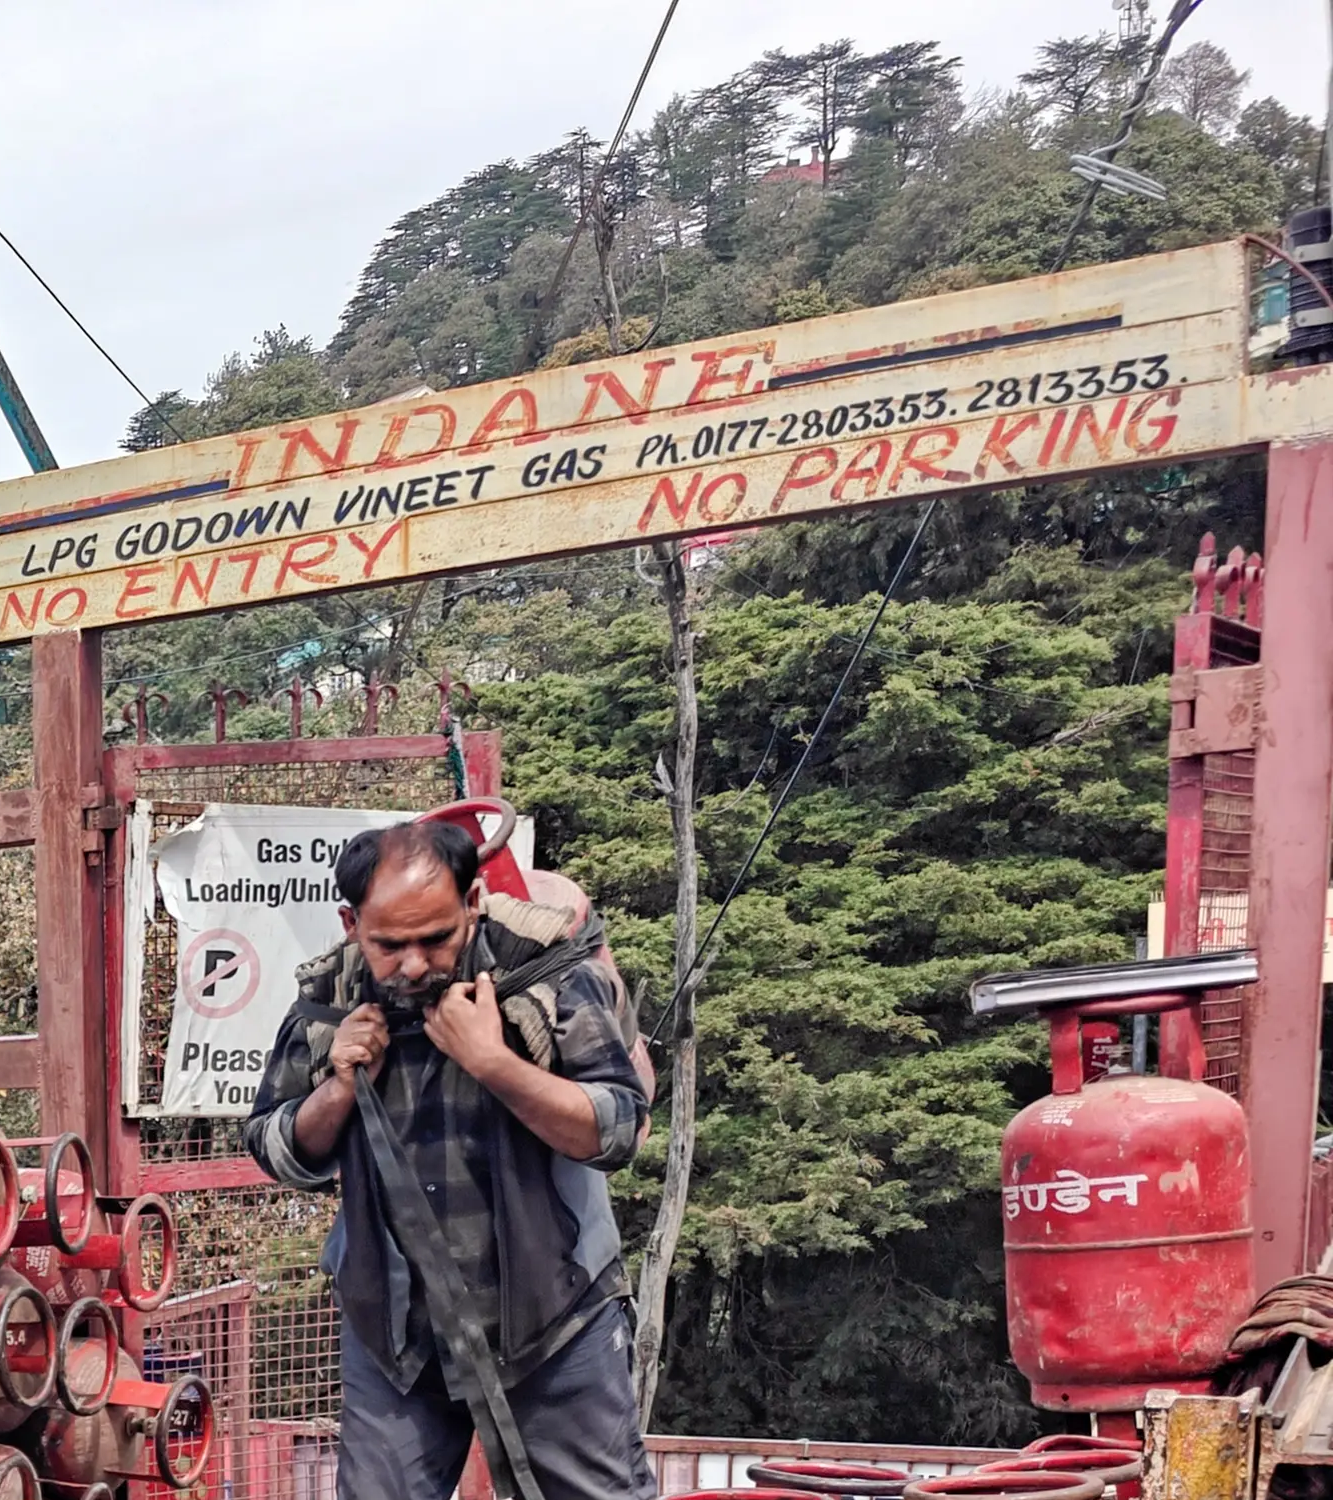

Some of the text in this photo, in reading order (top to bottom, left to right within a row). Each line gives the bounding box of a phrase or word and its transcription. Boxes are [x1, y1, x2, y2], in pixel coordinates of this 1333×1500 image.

[225, 340, 776, 499] INDANE
[635, 388, 1184, 535] NO PARKING
[21, 532, 98, 577] LPG
[115, 497, 310, 562] GODOWN
[333, 464, 495, 525] VINEET
[521, 443, 605, 489] GAS
[114, 520, 404, 620] ENTRY
[257, 838, 302, 863] Gas
[6, 1328, 27, 1348] 5.4
